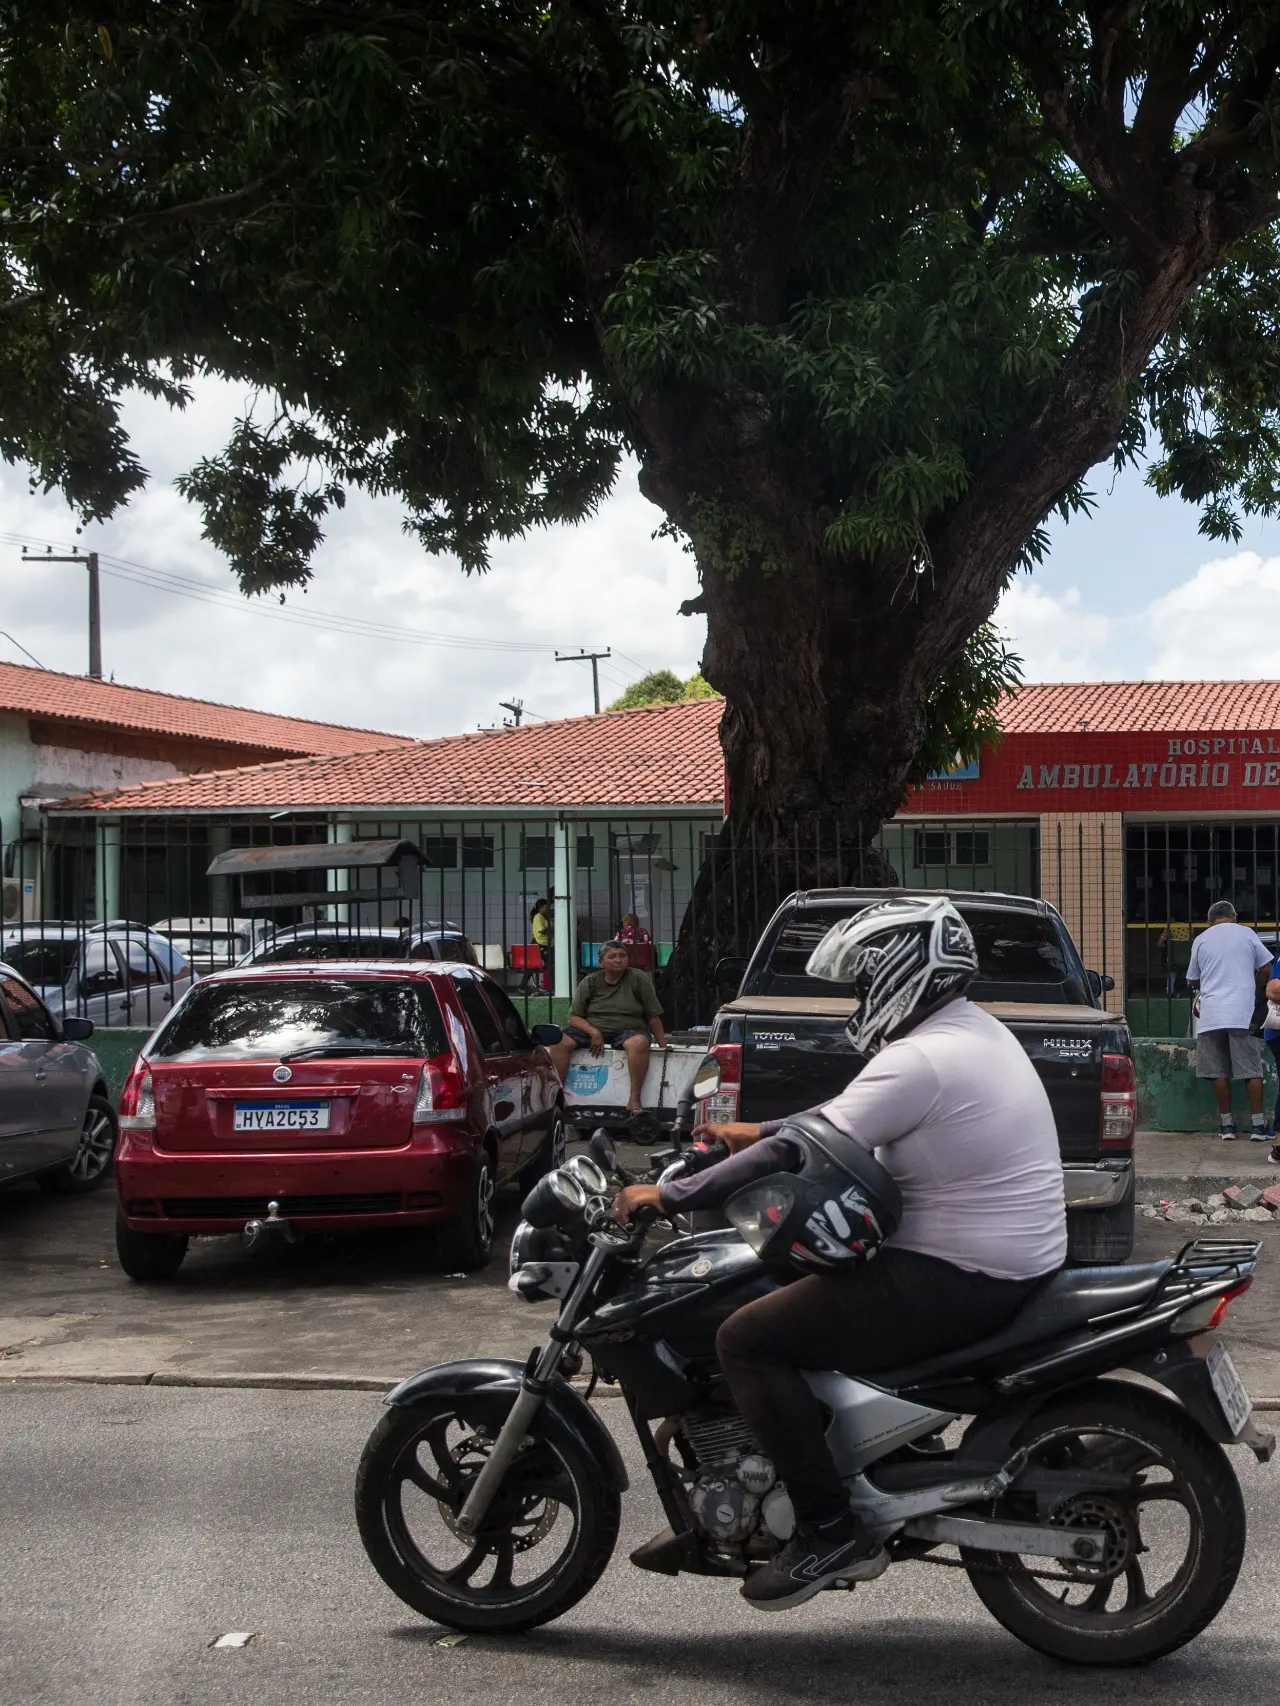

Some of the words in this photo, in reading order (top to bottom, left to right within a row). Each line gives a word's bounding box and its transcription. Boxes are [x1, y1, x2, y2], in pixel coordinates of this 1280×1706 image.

[1168, 737, 1280, 755] HOSPITAL
[752, 1032, 796, 1041] TOYOTA
[1043, 1038, 1093, 1048] HILUX
[1059, 1049, 1093, 1058] SRV
[243, 1110, 320, 1129] HYA2C53
